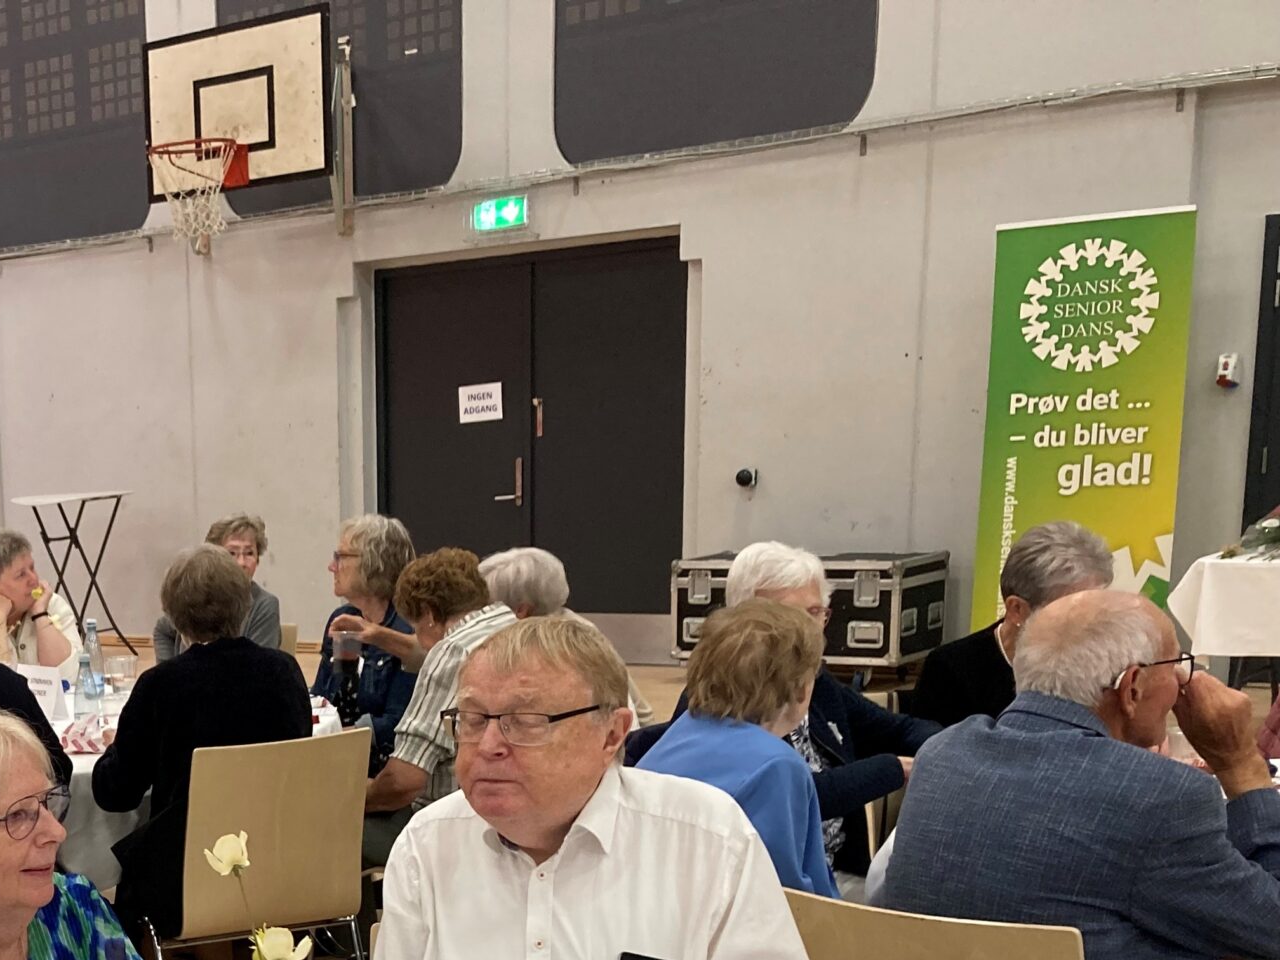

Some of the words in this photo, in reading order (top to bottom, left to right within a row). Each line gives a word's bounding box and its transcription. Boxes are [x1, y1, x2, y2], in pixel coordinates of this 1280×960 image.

[1056, 278, 1124, 298] DANSK
[1053, 299, 1124, 319] SENIOR
[1061, 320, 1114, 339] DANS
[467, 391, 493, 401] INGEN
[1009, 392, 1069, 415] Prøv
[1076, 387, 1120, 411] det
[463, 404, 498, 414] ADGANG
[1033, 424, 1066, 448] du
[1073, 422, 1149, 446] bliver
[1057, 452, 1153, 496] glad!
